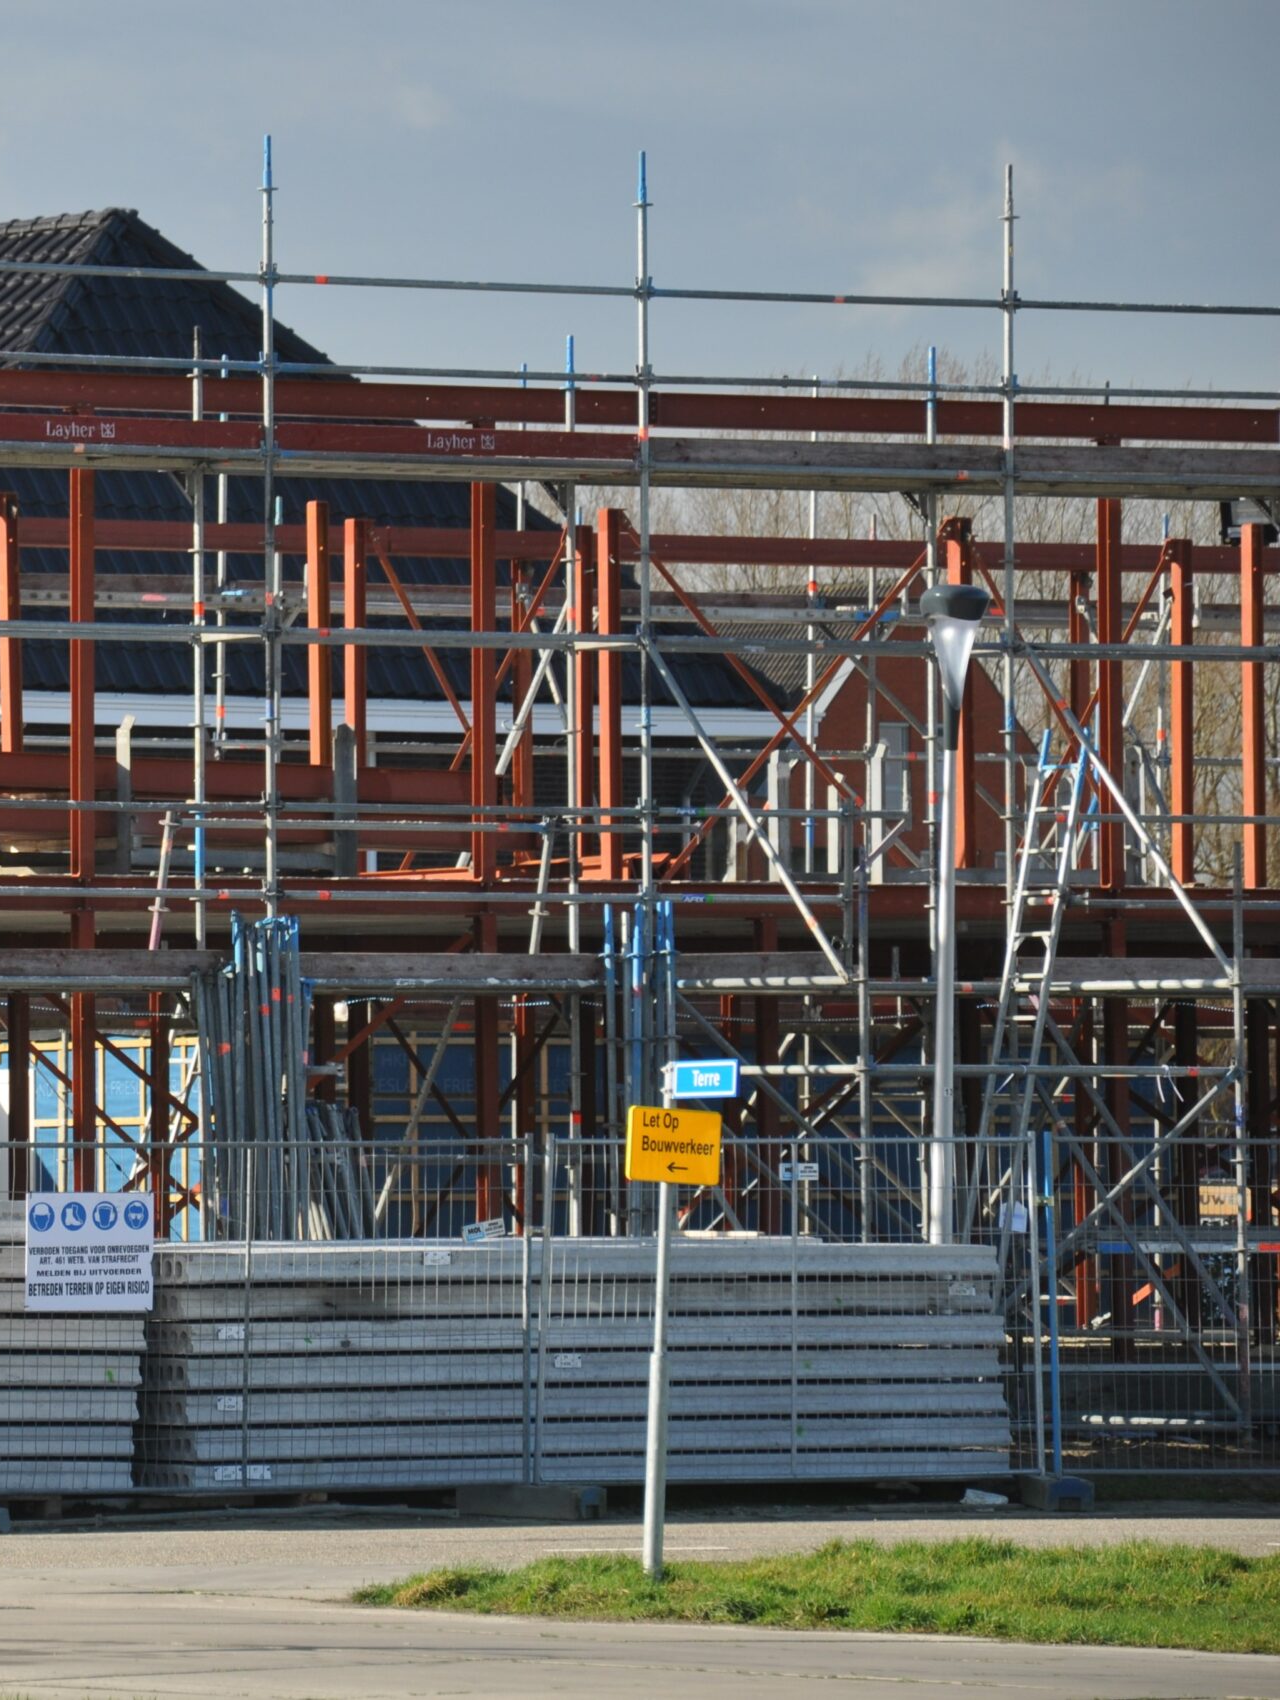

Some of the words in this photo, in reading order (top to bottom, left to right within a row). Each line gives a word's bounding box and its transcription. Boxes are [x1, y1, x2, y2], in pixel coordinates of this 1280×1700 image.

[46, 420, 96, 440] Layher
[427, 433, 476, 452] Layher
[691, 1069, 721, 1087] Terre
[642, 1112, 660, 1128] Let
[663, 1113, 679, 1133] Op
[641, 1135, 715, 1156] Bouwverkeer
[28, 1246, 60, 1256] VERBODEN
[61, 1246, 89, 1255] TOEGANG
[90, 1246, 106, 1254] VOOR
[107, 1245, 150, 1254] ONBEVOEGDEN
[39, 1256, 53, 1265] ART.
[55, 1256, 66, 1265] 461
[88, 1255, 100, 1264] VAN
[101, 1254, 139, 1264] STRAFRECHT
[36, 1269, 71, 1277] MELDEN
[73, 1269, 87, 1277] BIJ
[89, 1268, 142, 1276] UITVOERDER
[28, 1282, 64, 1297] BETREDEN
[65, 1282, 94, 1296] TERREIN
[95, 1281, 104, 1295] OP
[106, 1281, 126, 1295] EIGEN
[127, 1280, 150, 1294] RISICO
